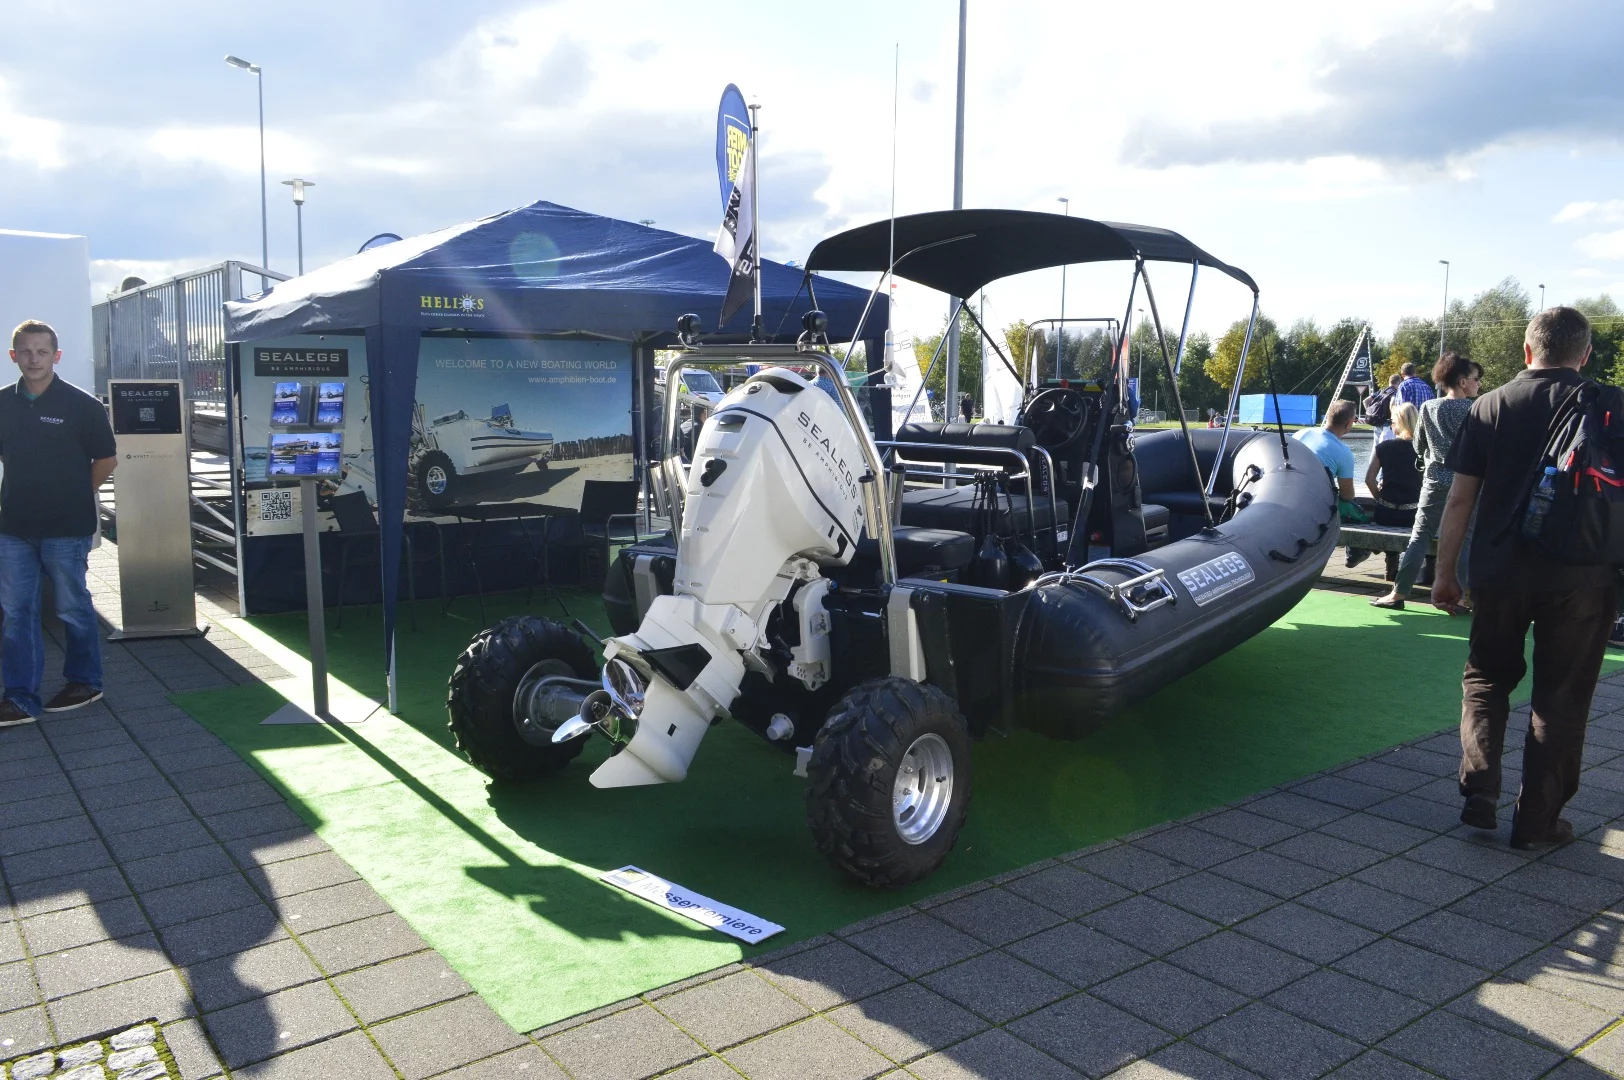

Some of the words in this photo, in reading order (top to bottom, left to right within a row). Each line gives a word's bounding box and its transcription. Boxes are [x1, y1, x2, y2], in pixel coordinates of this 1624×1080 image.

[259, 352, 340, 362] SEALEGS
[435, 359, 487, 369] WELCOME
[490, 360, 504, 369] TO
[506, 360, 514, 369] A
[516, 360, 538, 369] NEW
[541, 360, 582, 370] BOATING
[584, 361, 617, 370] WORLD
[527, 375, 617, 385] www.amphibien-boot.de
[802, 437, 812, 449] BE
[797, 411, 857, 499] SEALEGS
[1181, 555, 1247, 592] SEALEGS
